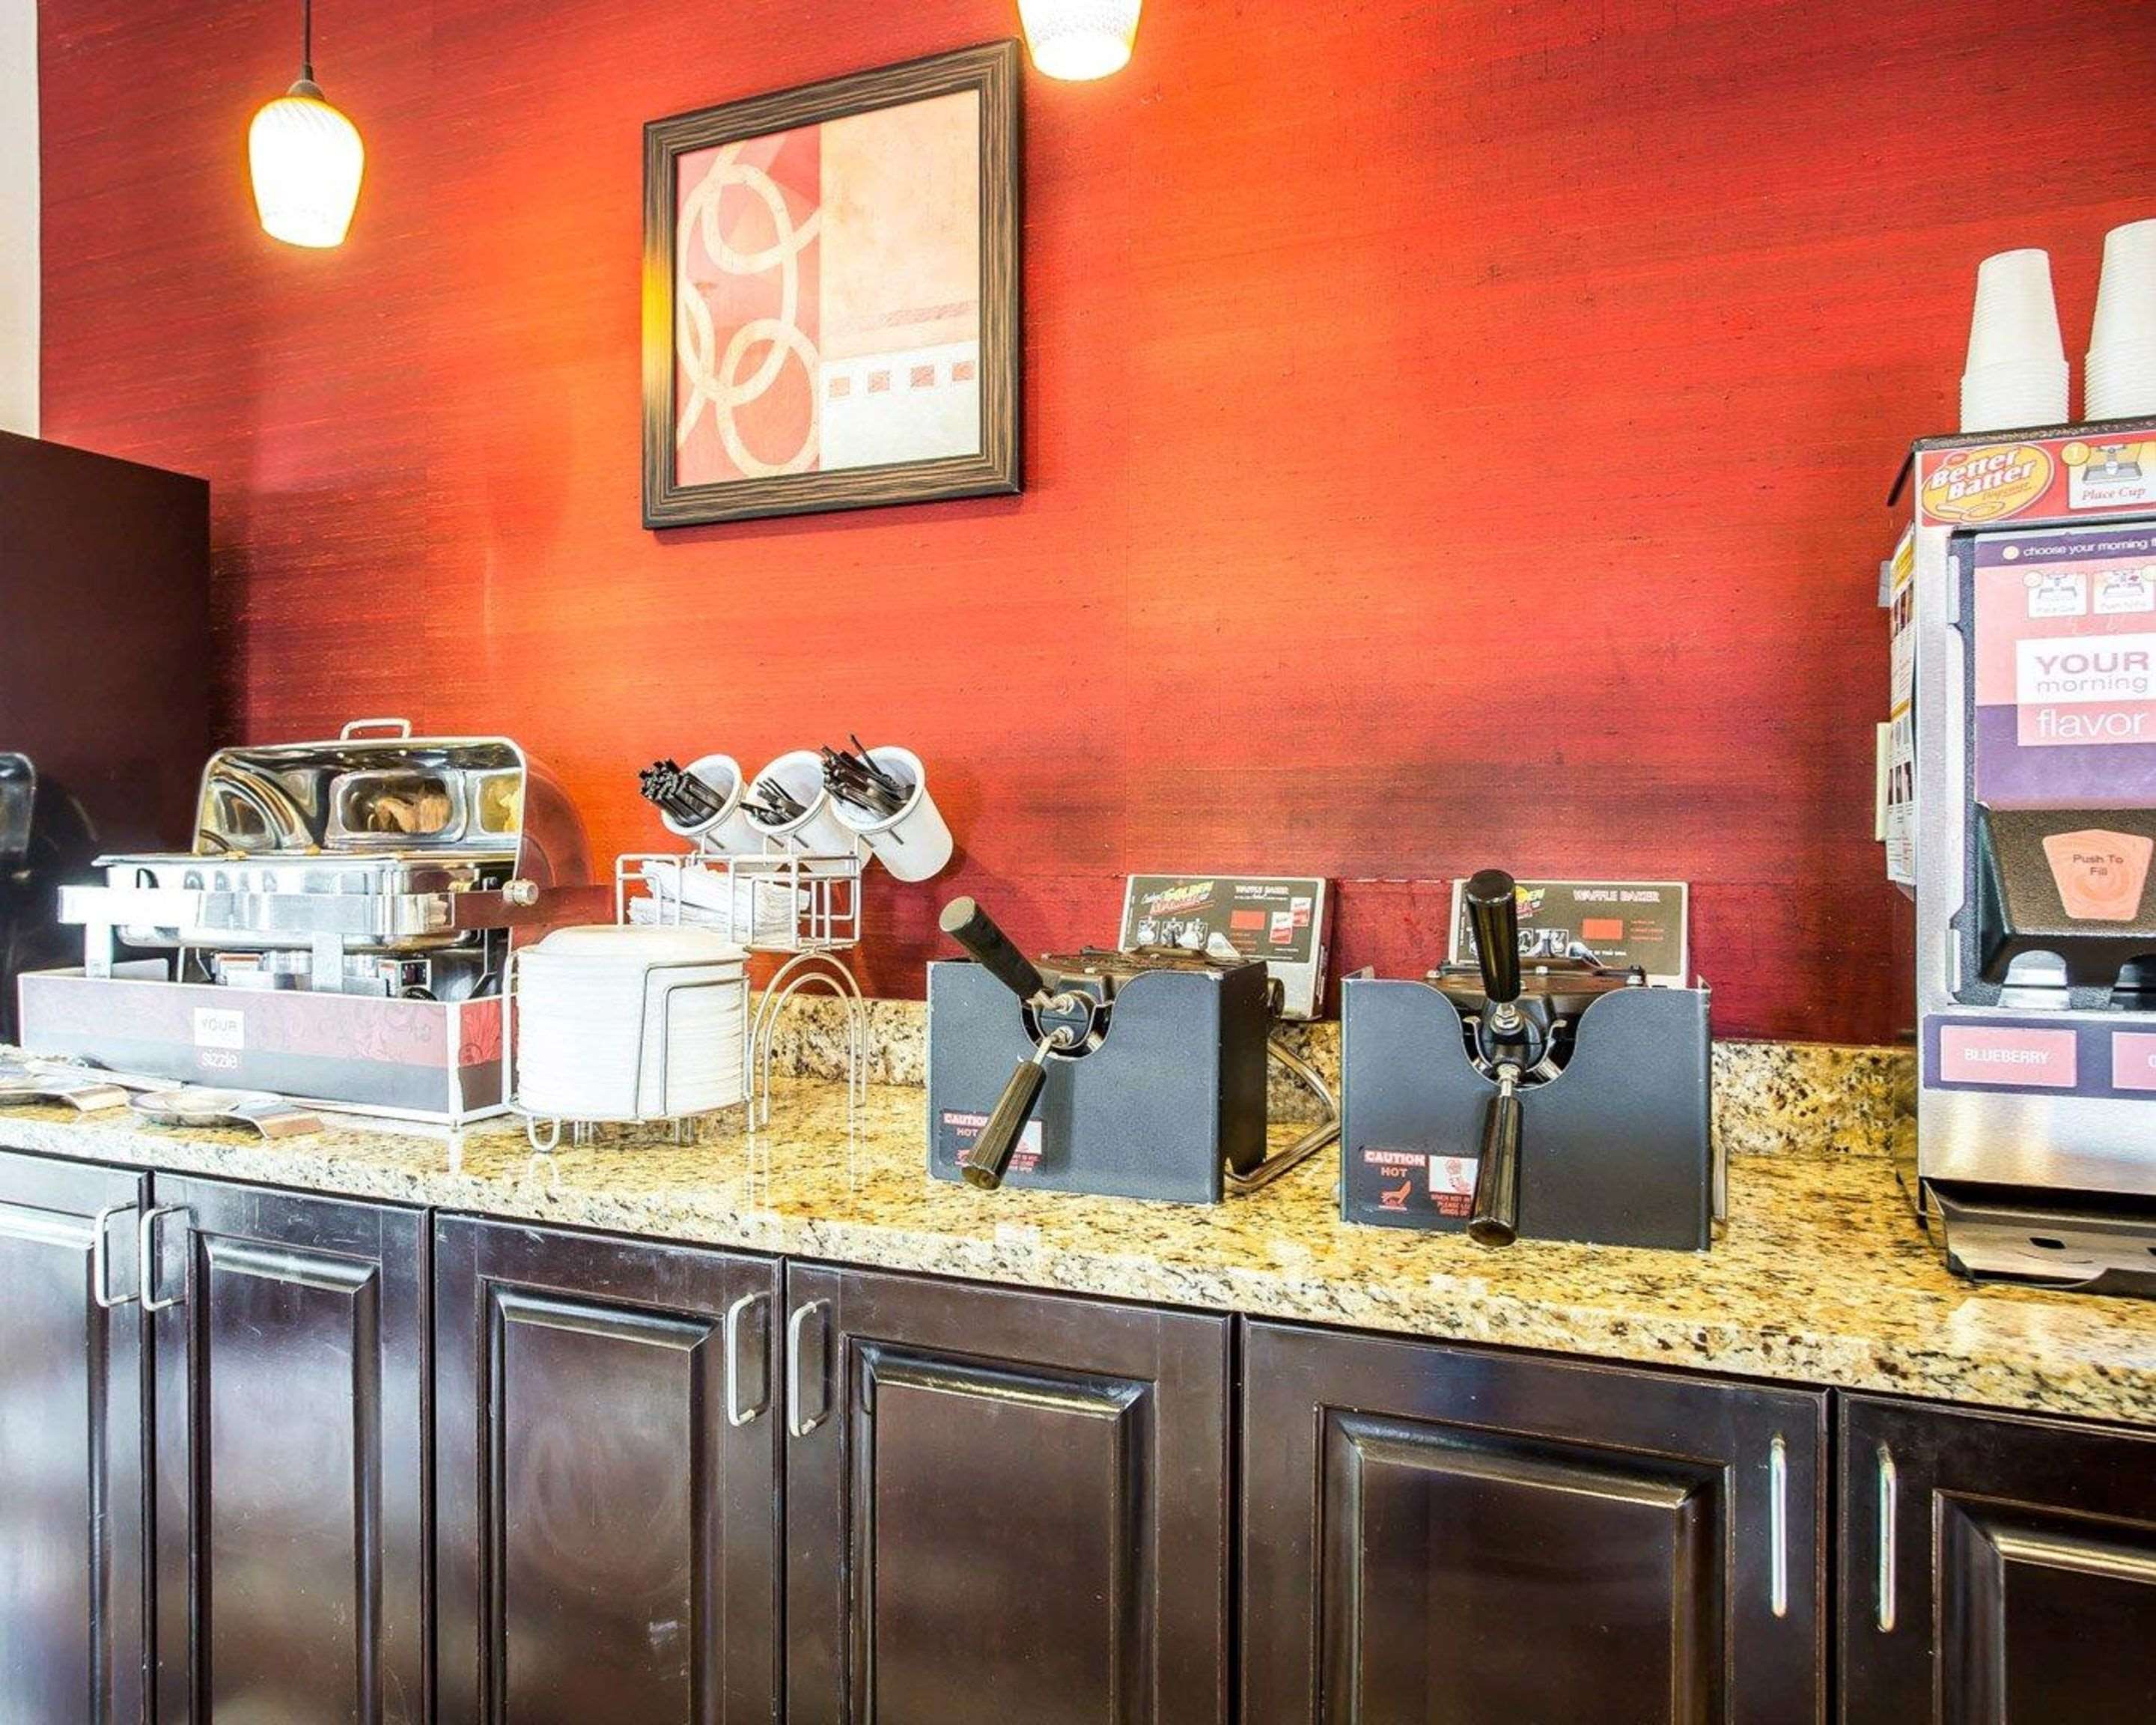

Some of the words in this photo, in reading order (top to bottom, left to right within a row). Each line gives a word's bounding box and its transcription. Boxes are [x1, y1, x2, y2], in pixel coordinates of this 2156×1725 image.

[2082, 489, 2116, 501] Place
[2119, 487, 2146, 499] Cup
[2023, 545, 2066, 556] choose
[2069, 544, 2095, 555] your
[2098, 538, 2148, 551] morning
[2034, 651, 2149, 675] YOUR
[2037, 675, 2149, 694] morning
[2036, 708, 2149, 737] flavor
[2073, 854, 2104, 863] Push
[2107, 854, 2124, 863] To
[2090, 867, 2108, 876] Fill
[201, 1017, 238, 1032] YOUR
[1964, 1047, 2050, 1065] BLUEBERRY
[957, 1127, 979, 1137] HOT
[1365, 1150, 1425, 1166] CAUTION
[1380, 1167, 1408, 1178] HOT
